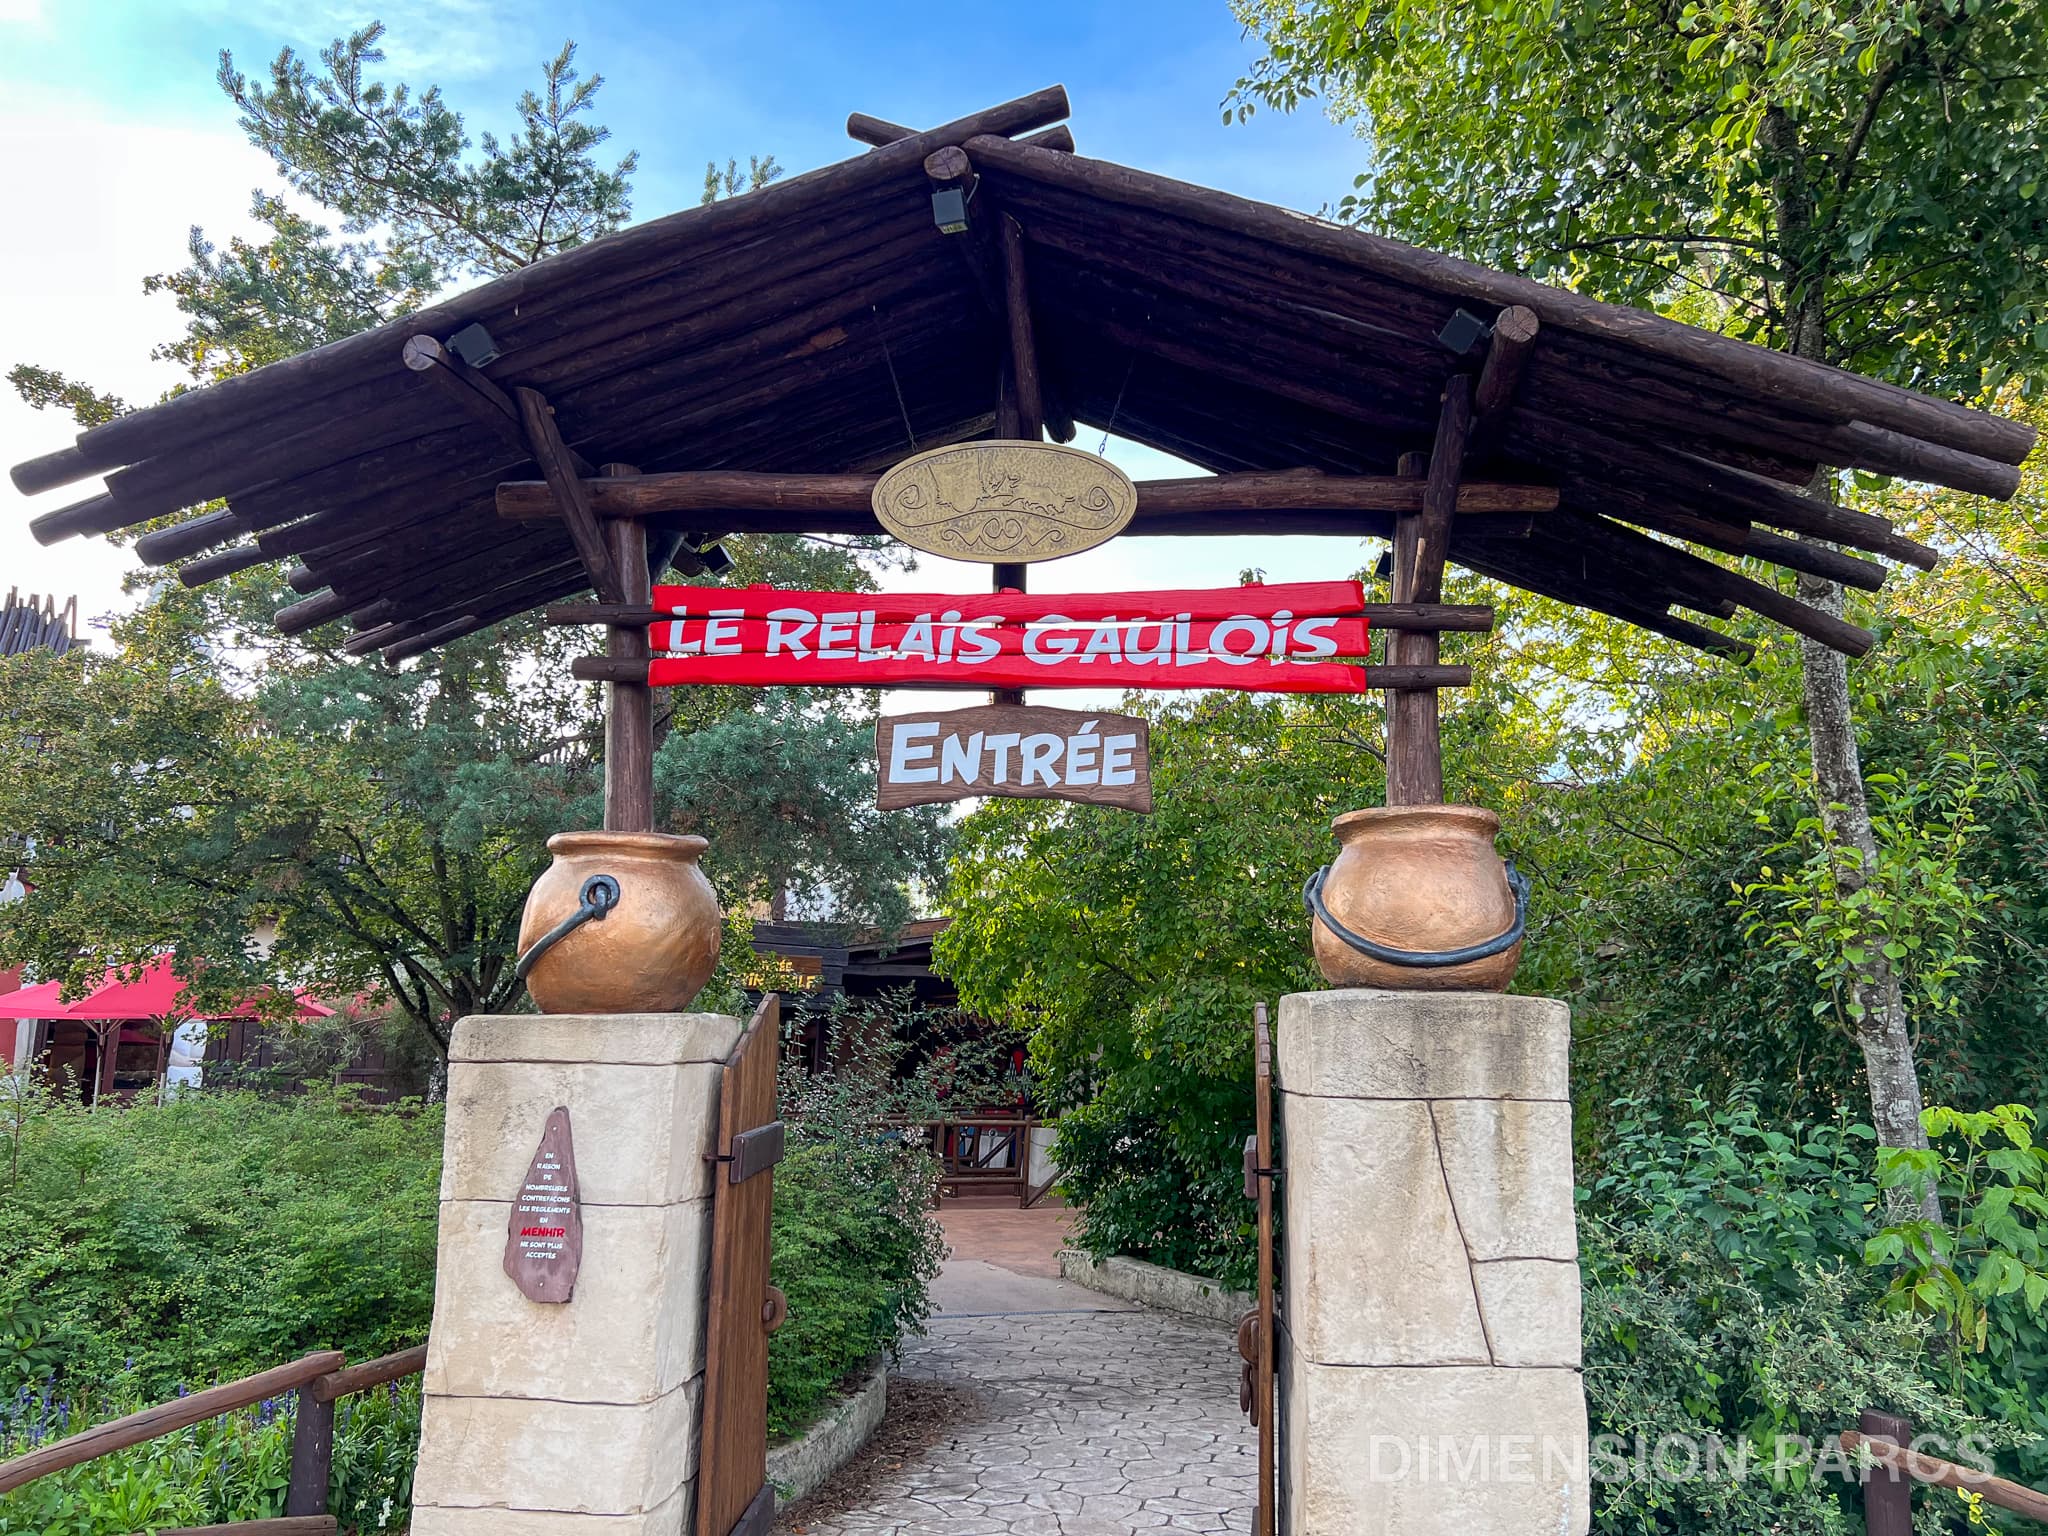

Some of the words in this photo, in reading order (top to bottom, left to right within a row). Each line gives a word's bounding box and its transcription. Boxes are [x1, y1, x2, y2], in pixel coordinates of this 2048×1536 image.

[670, 606, 745, 656] LE
[888, 719, 1138, 788] ENTRÉE
[525, 1184, 568, 1192] NOMBREUSES
[520, 1227, 565, 1238] MENHIR
